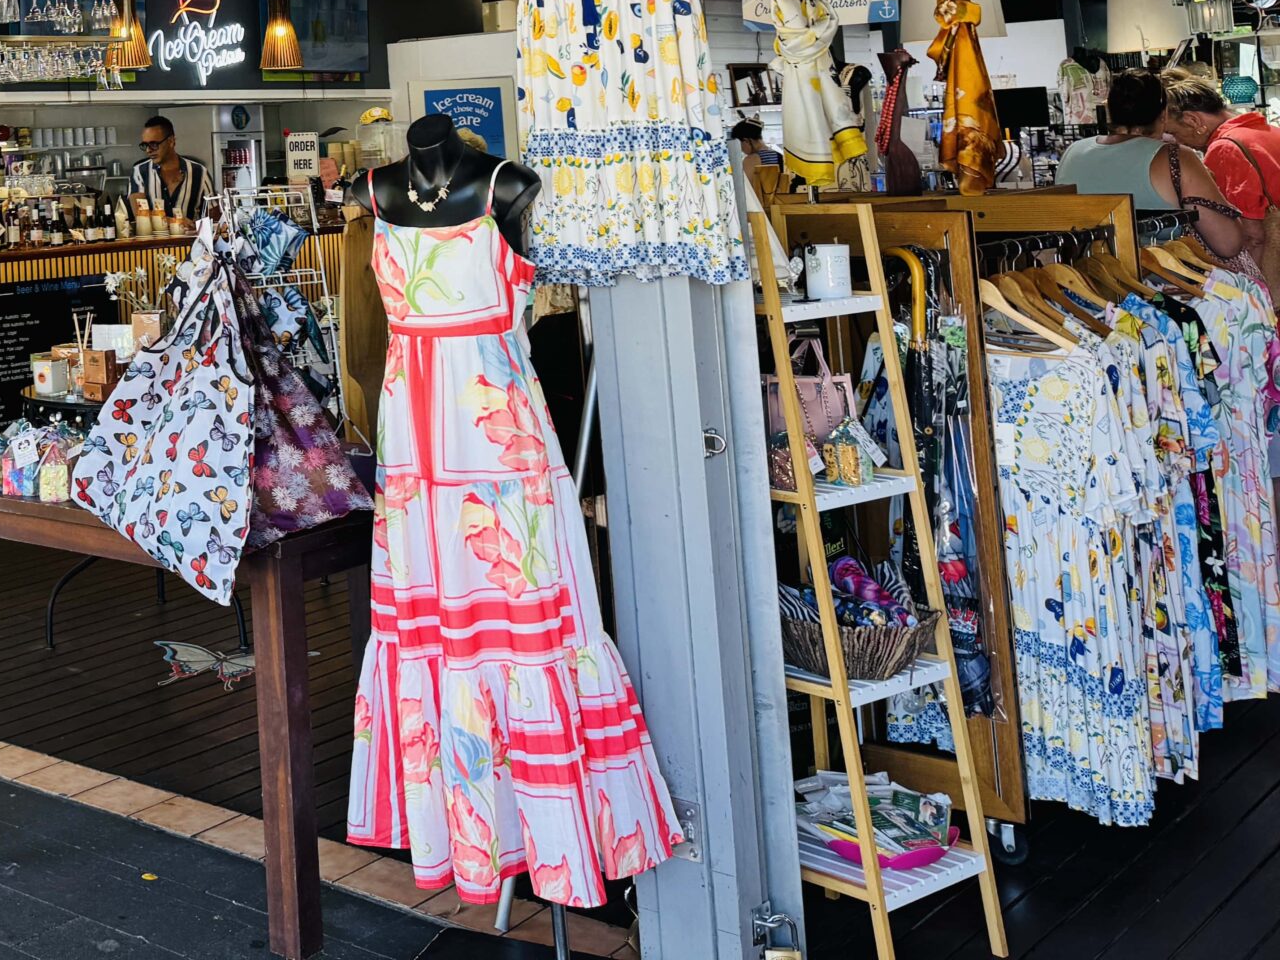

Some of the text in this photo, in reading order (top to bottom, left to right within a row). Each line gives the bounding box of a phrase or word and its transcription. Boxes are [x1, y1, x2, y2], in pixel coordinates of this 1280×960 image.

[149, 21, 244, 71] Ice Cream
[433, 93, 494, 112] Ice-cream
[454, 105, 473, 113] those
[474, 107, 488, 117] who
[289, 140, 316, 152] ORDER
[293, 158, 313, 170] HERE
